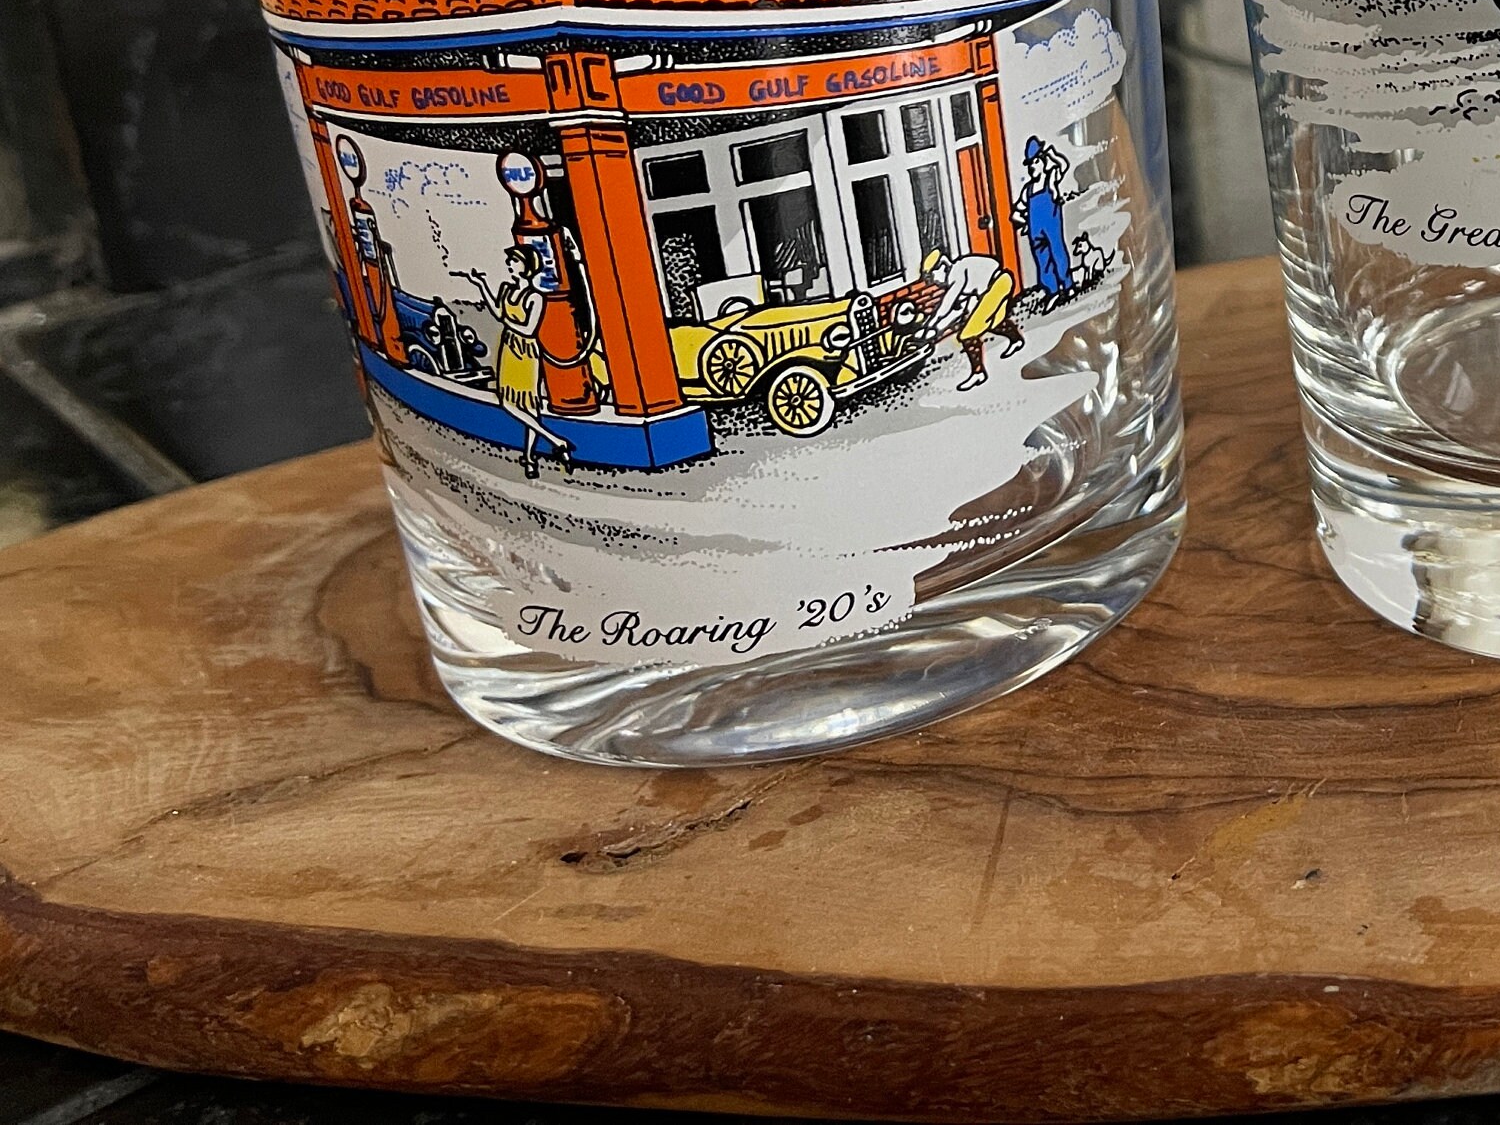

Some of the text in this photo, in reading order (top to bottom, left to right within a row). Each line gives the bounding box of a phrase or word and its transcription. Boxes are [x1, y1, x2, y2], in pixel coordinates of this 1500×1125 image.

[315, 77, 511, 110] GOOD GULF GASOLINE
[658, 56, 942, 106] GOOD GULF GASOLINE
[1345, 194, 1411, 238] The
[517, 604, 591, 644] The
[600, 610, 777, 654] Roaring
